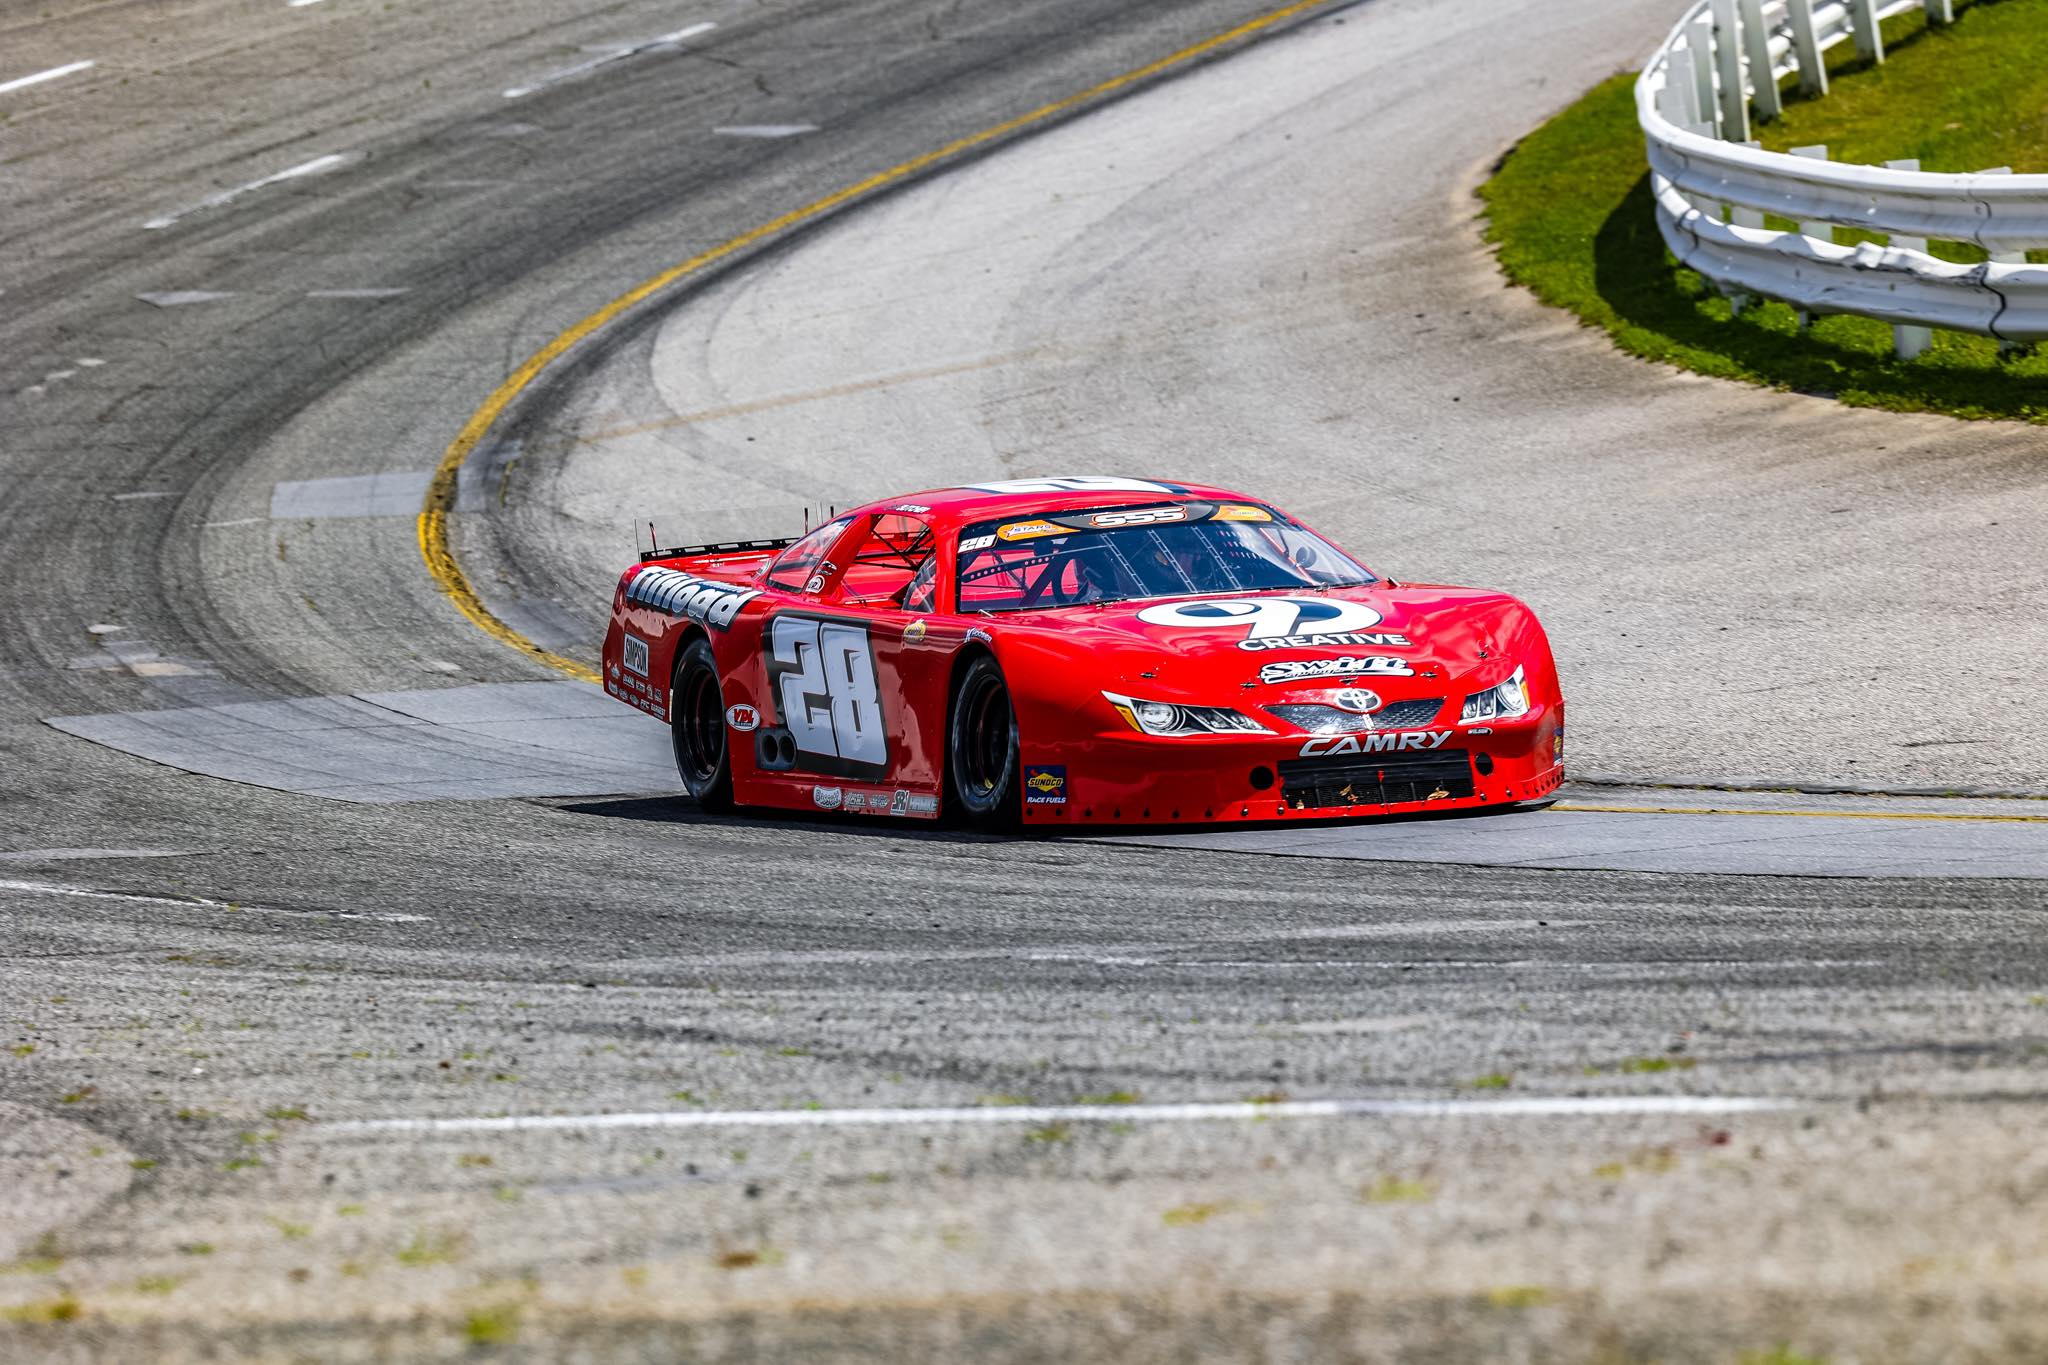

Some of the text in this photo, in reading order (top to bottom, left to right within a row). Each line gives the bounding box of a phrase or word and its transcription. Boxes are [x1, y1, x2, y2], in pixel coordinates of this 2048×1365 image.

[1094, 506, 1185, 527] SSS
[958, 535, 996, 553] 28
[1237, 633, 1413, 651] CREATIVE
[772, 616, 887, 765] 28
[1299, 730, 1453, 757] CAMRY
[1029, 778, 1062, 787] SUNOCO
